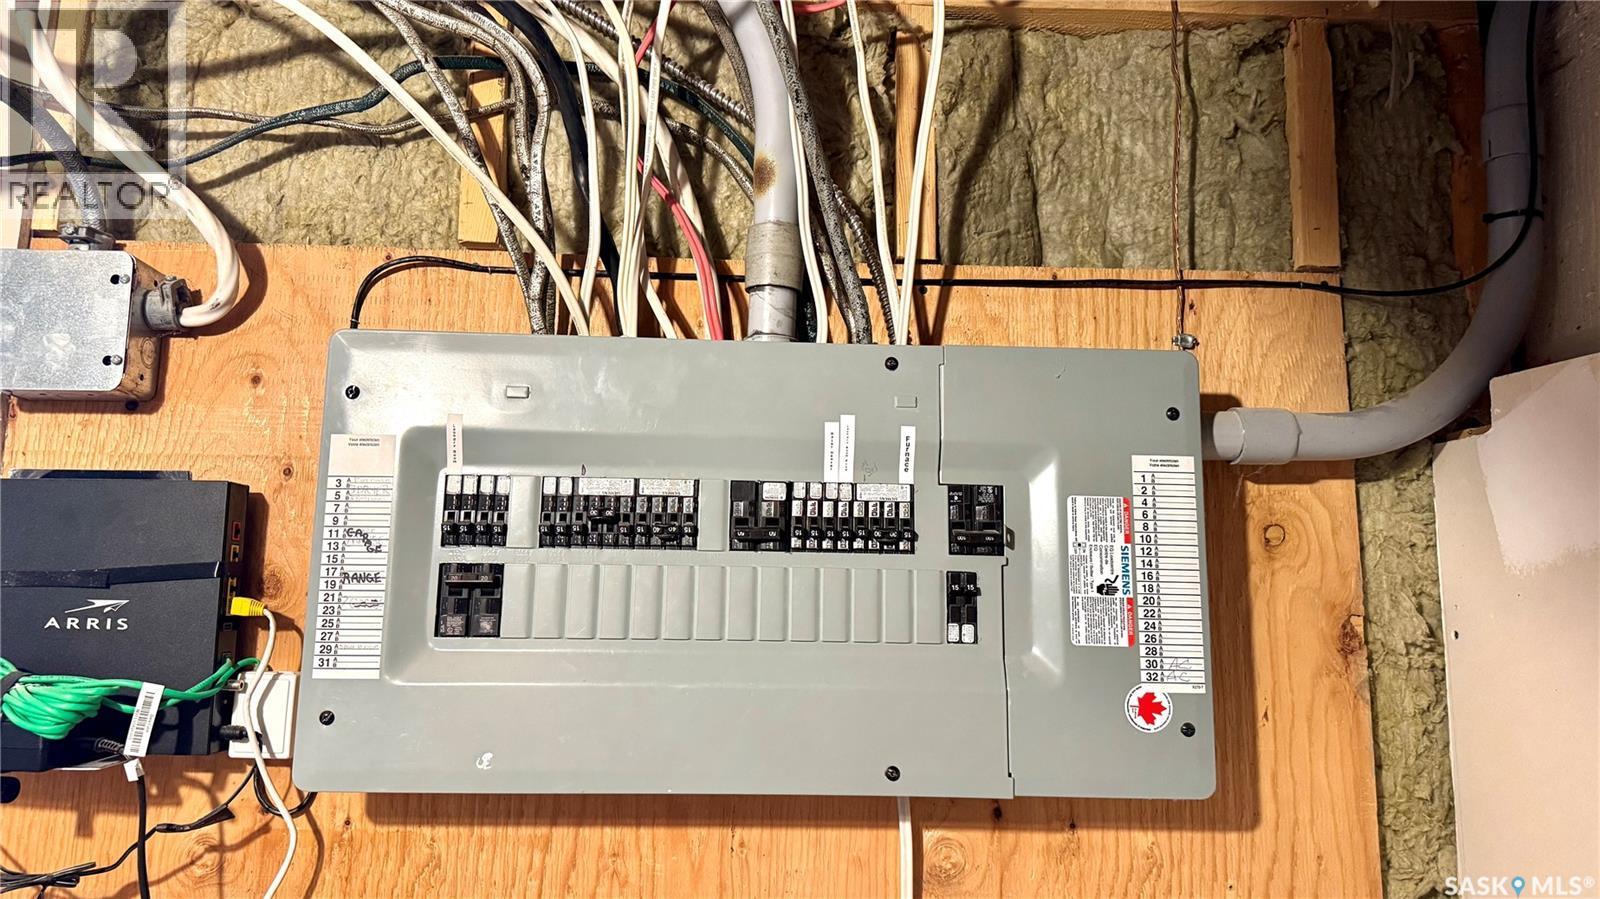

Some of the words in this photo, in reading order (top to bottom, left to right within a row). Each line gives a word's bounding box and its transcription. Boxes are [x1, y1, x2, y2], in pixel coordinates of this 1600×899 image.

[336, 479, 341, 487] 3
[334, 492, 340, 500] 5
[1142, 499, 1147, 507] 4
[334, 504, 340, 512] 7
[1142, 511, 1148, 519] 6
[333, 517, 338, 525] 9
[1143, 523, 1149, 531] 8
[328, 529, 339, 537] 11
[1140, 535, 1151, 543] 10
[327, 542, 338, 550] 13
[1141, 547, 1152, 555] 12
[326, 555, 338, 563] 15
[1141, 559, 1152, 567] 14
[325, 568, 337, 576] 17
[1121, 546, 1131, 595] SIEMENS
[342, 572, 382, 584] RANGE
[1142, 572, 1153, 580] 16
[325, 580, 336, 589] 19
[1142, 584, 1153, 592] 18
[324, 593, 334, 601] 21
[1143, 597, 1155, 605] 20
[323, 606, 335, 614] 23
[1144, 609, 1155, 617] 22
[44, 616, 129, 631] ARRIS
[322, 619, 334, 627] 25
[1144, 622, 1156, 630] 24
[321, 632, 333, 640] 27
[1145, 634, 1157, 643] 26
[320, 645, 332, 654] 29
[1145, 647, 1157, 655] 28
[318, 658, 330, 667] 31
[1146, 660, 1158, 668] 30
[1146, 673, 1158, 681] 32
